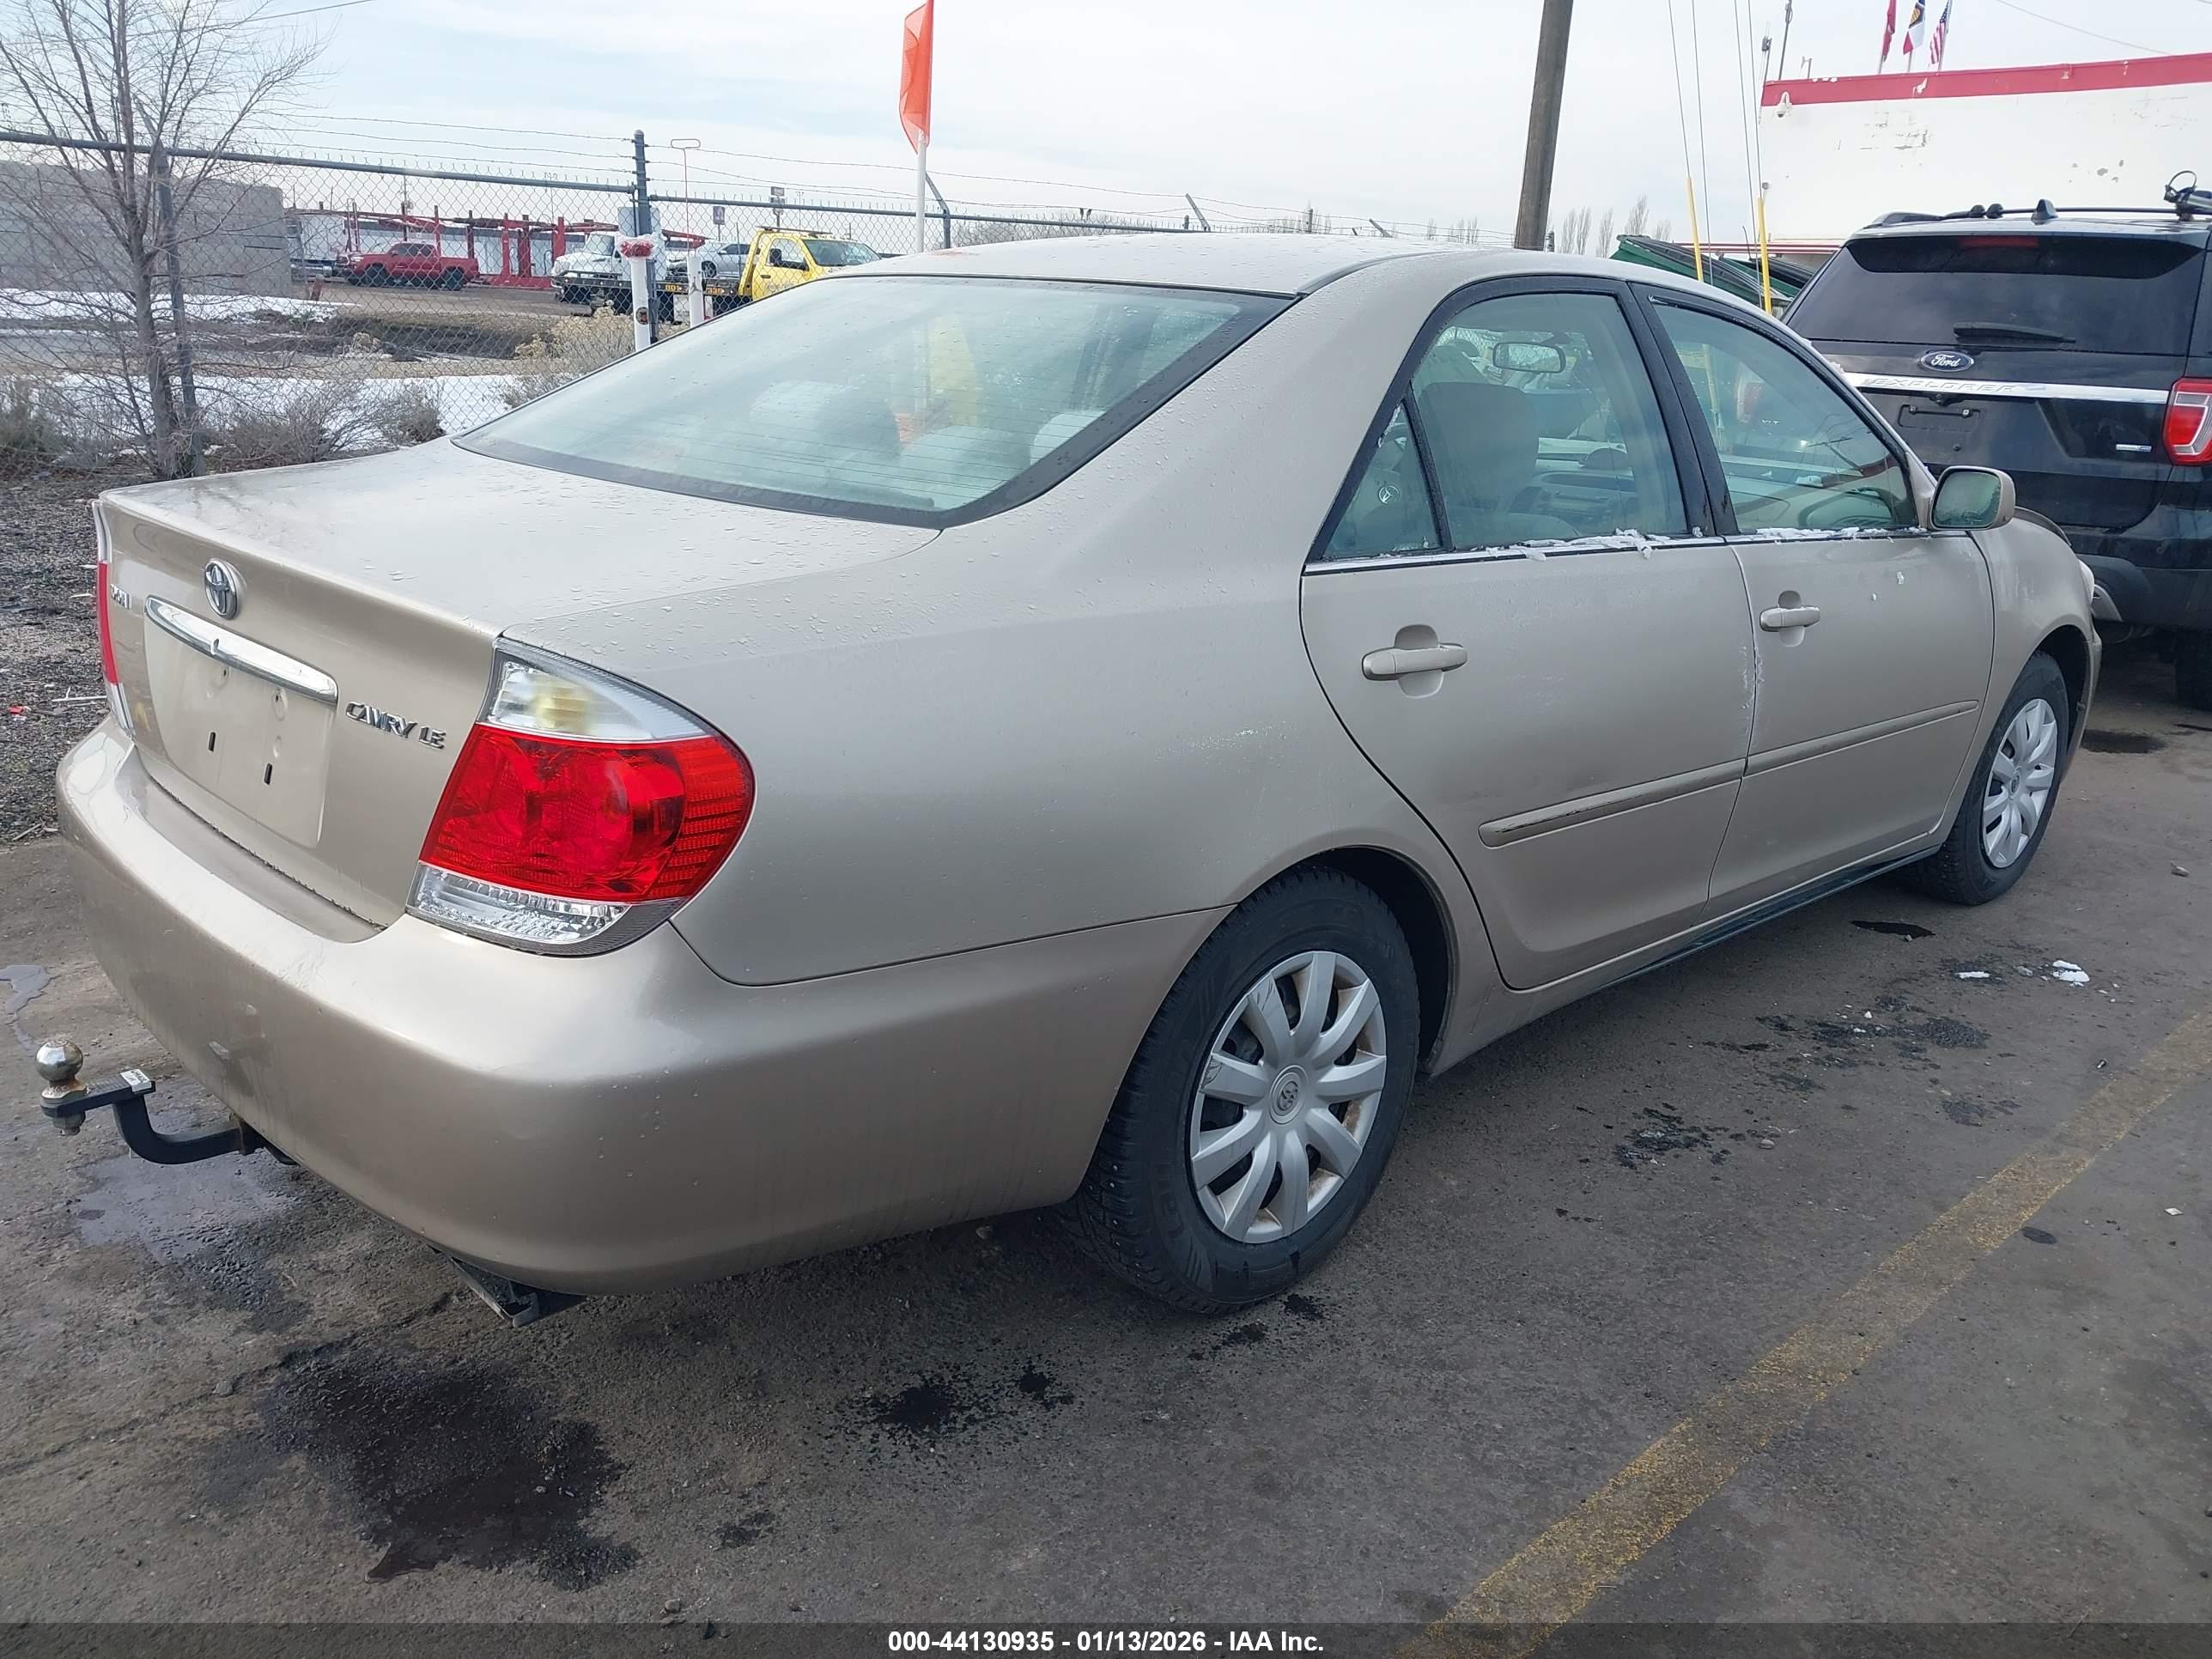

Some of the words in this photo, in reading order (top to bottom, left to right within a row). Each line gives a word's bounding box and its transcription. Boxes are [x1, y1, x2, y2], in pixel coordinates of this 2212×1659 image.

[1931, 354, 1961, 368] Ford
[1870, 378, 2020, 394] EXPLORER
[345, 701, 418, 738] CAMRY
[418, 726, 447, 750] LE
